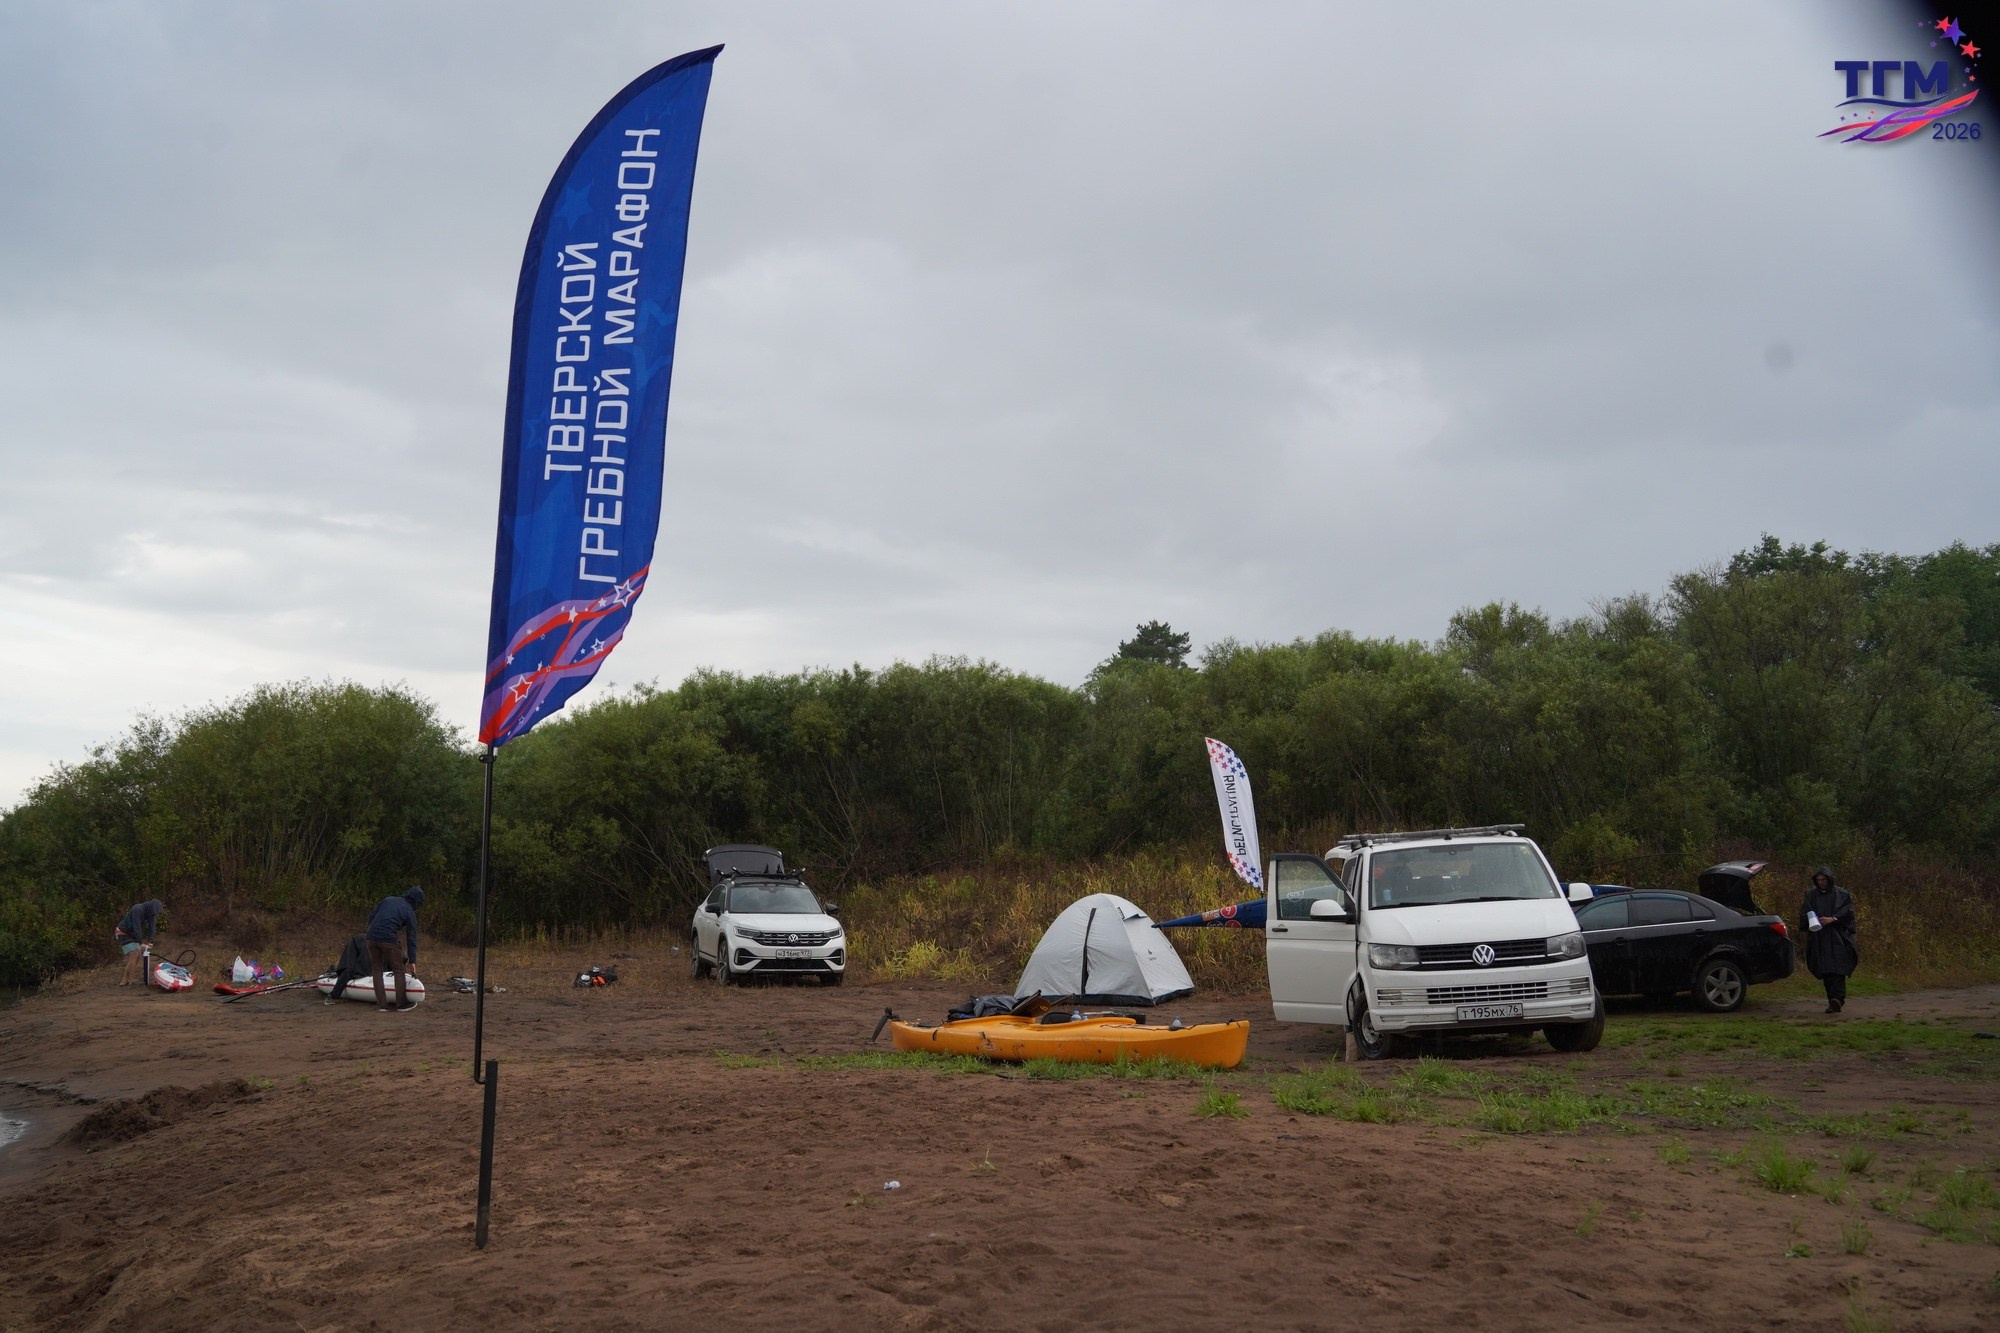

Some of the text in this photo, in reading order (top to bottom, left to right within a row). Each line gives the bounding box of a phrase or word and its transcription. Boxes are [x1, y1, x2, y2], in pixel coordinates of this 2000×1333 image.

[543, 241, 599, 482] ТВЕРСКОЙ
[578, 127, 662, 585] ГРЕБНОЙ МАРАФОН
